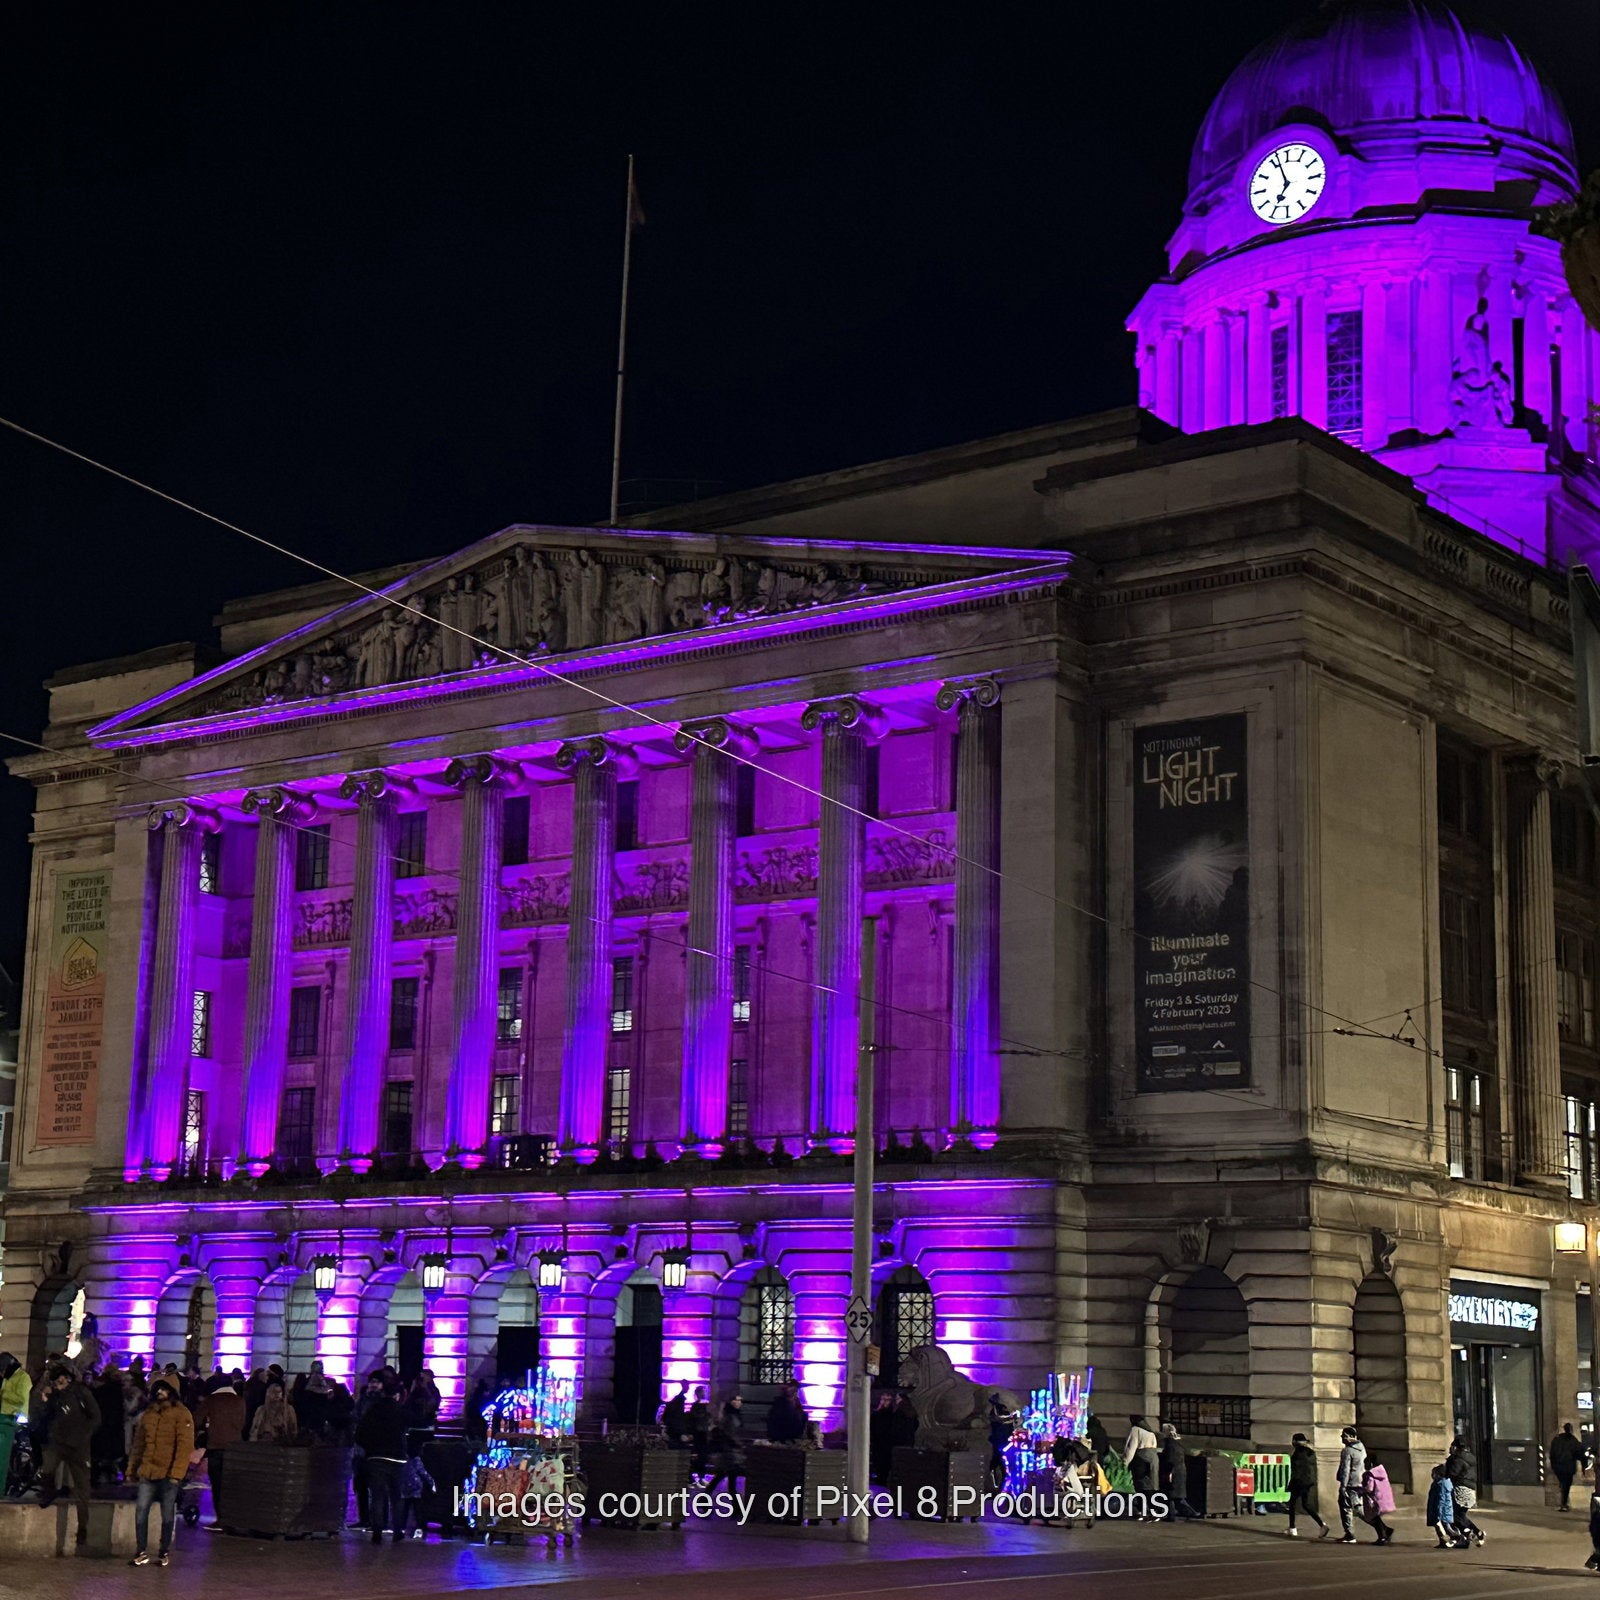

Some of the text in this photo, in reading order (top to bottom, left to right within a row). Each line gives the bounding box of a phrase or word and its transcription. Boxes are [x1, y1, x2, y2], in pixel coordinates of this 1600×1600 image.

[1143, 735, 1201, 753] NOTTINGHAM
[1143, 746, 1221, 784] LIGHT
[1159, 772, 1238, 810] NIGHT
[62, 890, 75, 900] THE
[66, 911, 91, 922] PEOPLE
[61, 921, 105, 934] NOTTINGHAM
[1172, 952, 1208, 970] your
[1145, 967, 1236, 987] imagination
[51, 999, 80, 1012] SUNDAY
[1144, 993, 1239, 1008] Friday 3 & Saturday
[58, 1011, 93, 1023] JANUARY
[1152, 1004, 1231, 1019] 4 February 2023
[849, 1310, 869, 1328] 25
